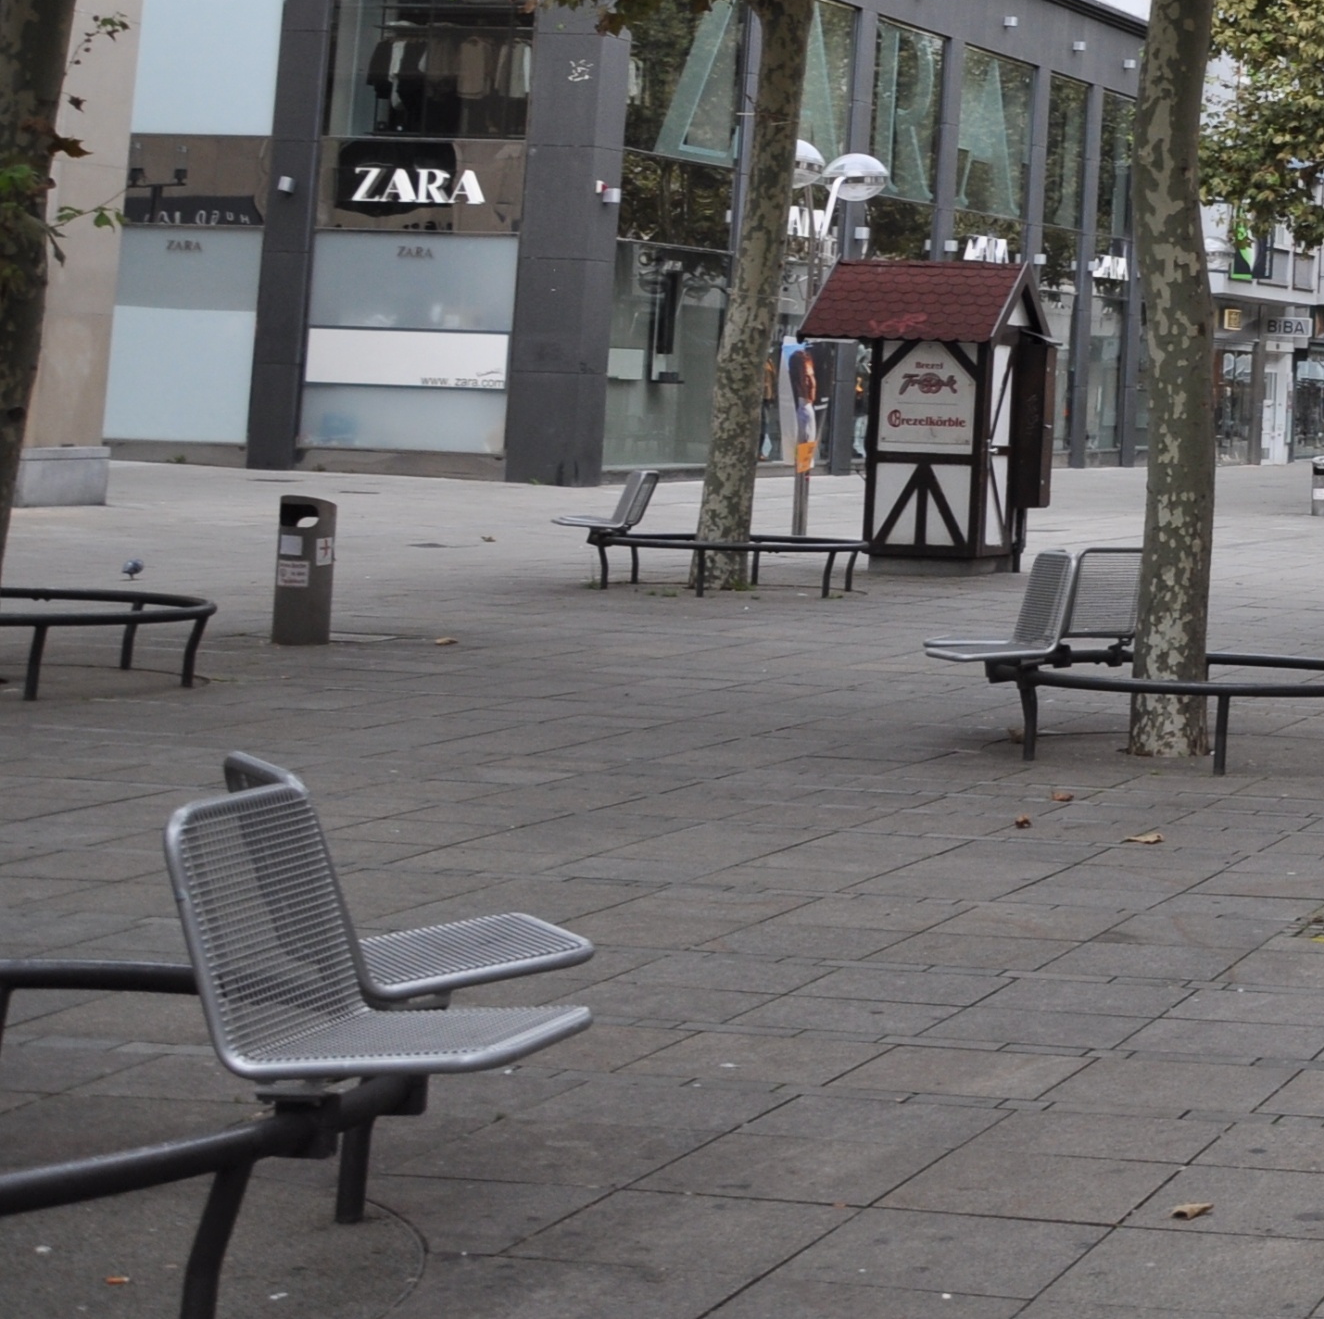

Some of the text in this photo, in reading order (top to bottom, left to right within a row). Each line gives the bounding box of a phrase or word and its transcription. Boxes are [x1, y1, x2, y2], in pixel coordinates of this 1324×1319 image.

[352, 166, 487, 205] ZARA
[166, 238, 203, 254] ZARA
[397, 244, 434, 260] ZARA
[1267, 318, 1305, 334] BiBA
[453, 378, 506, 389] zara.com
[886, 408, 967, 429] Brezelkörble
